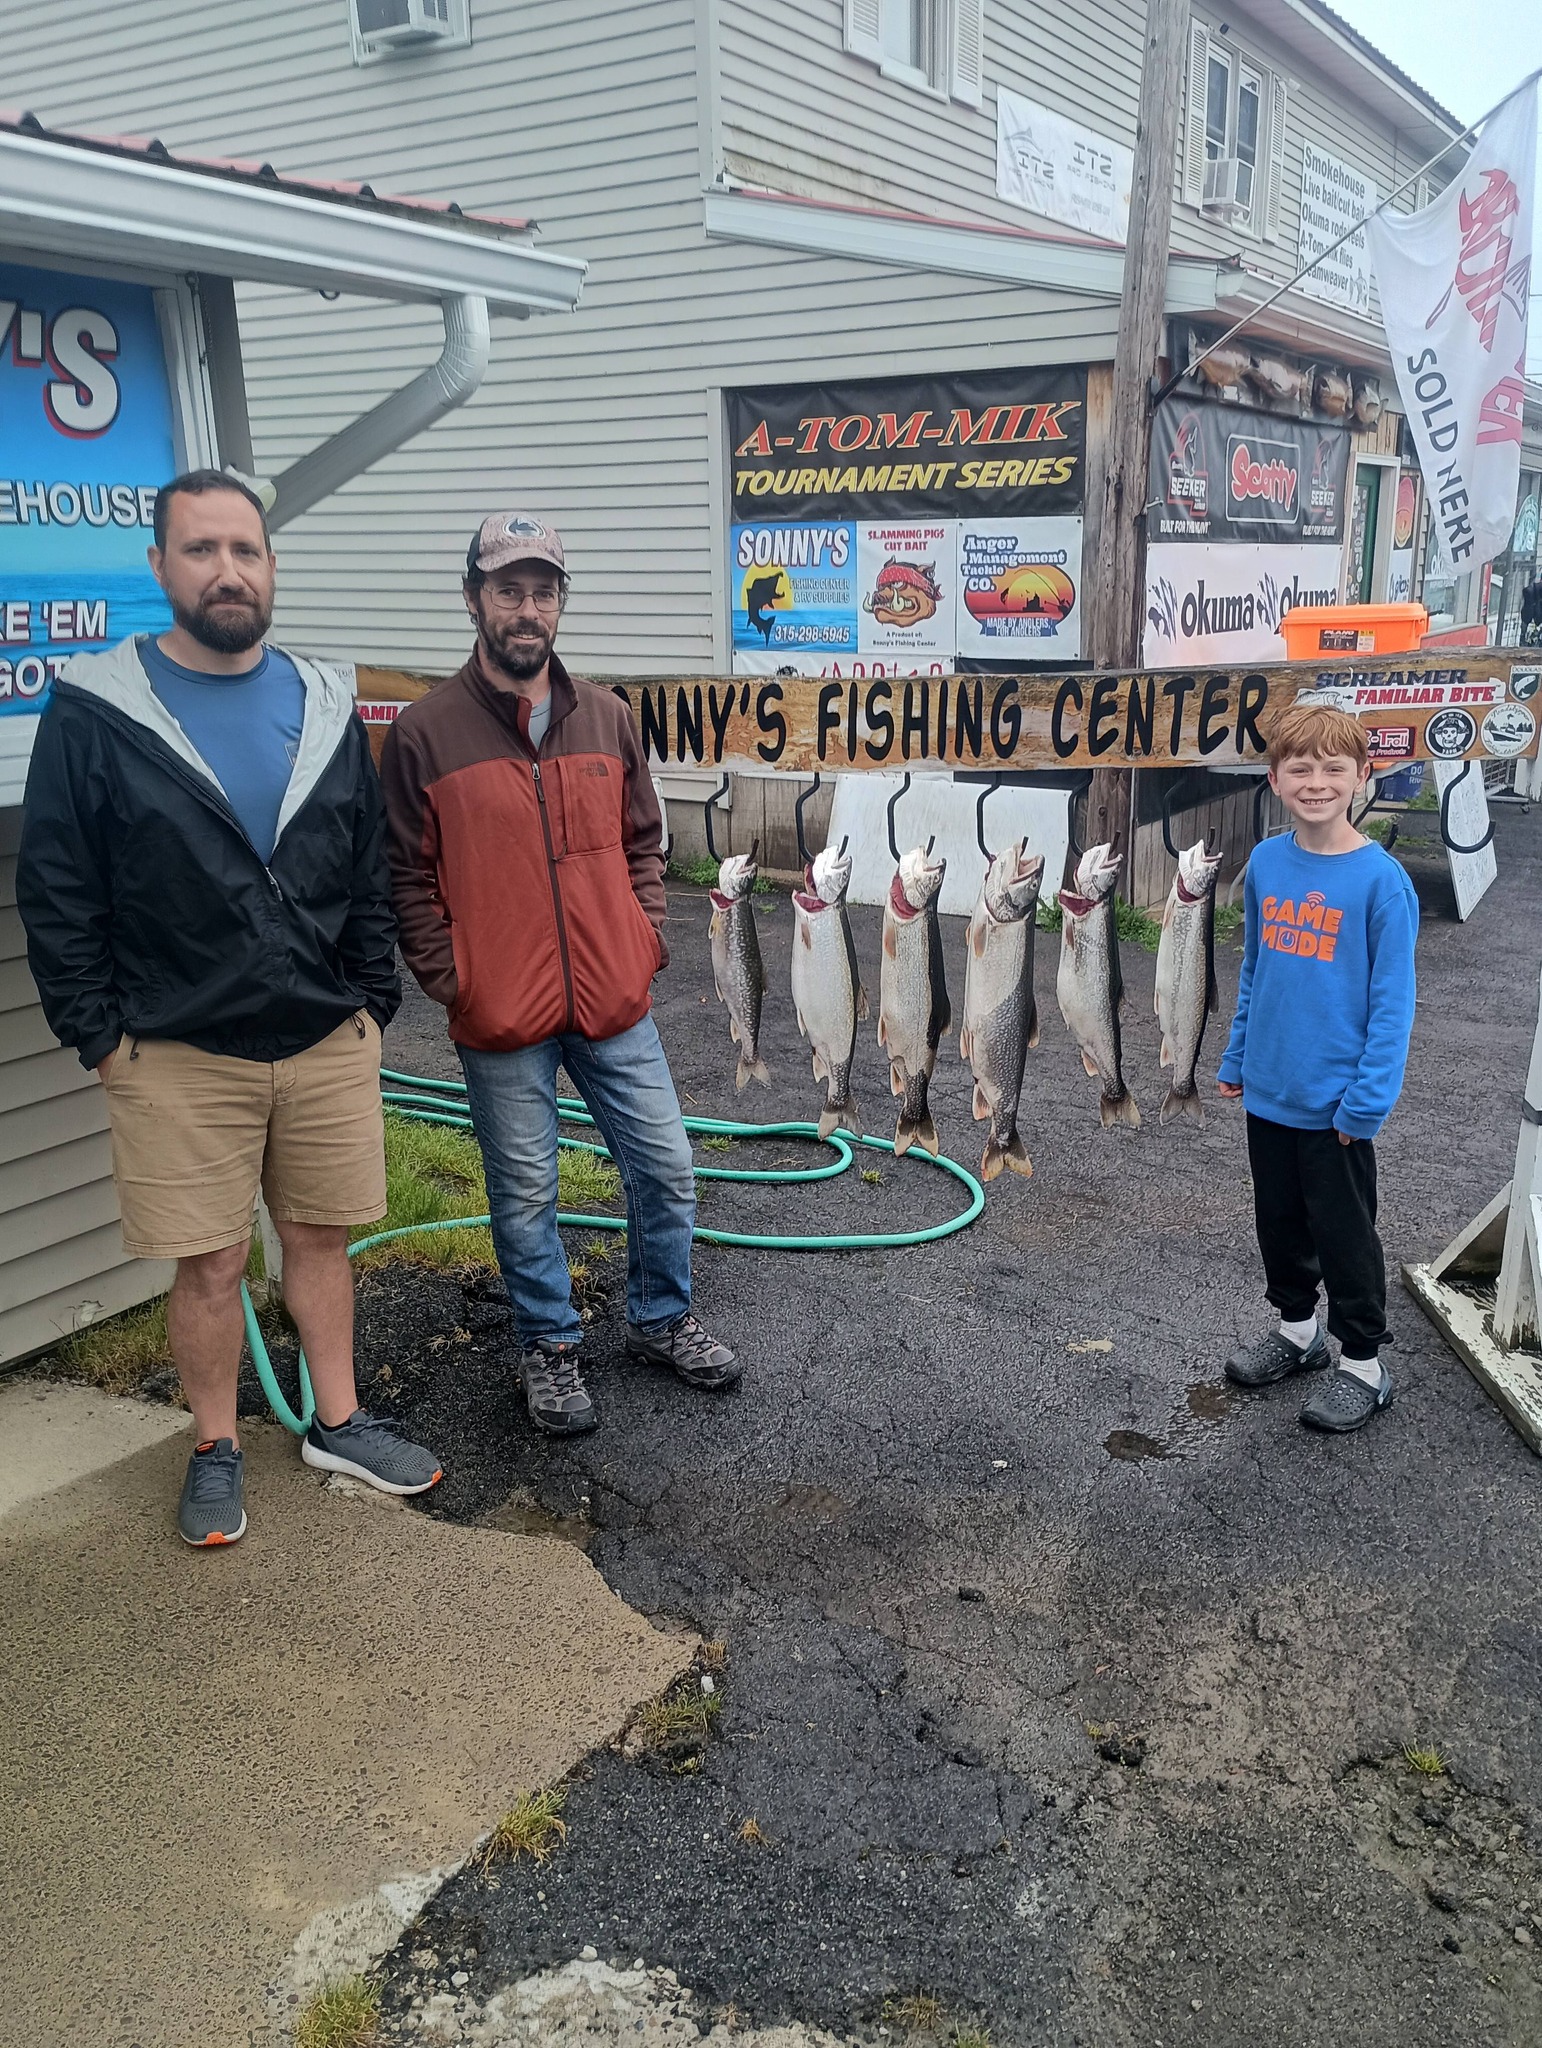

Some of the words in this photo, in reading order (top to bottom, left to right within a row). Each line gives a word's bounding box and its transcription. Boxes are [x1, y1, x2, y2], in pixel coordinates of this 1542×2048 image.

[1305, 146, 1365, 199] Smokehouse
[1303, 173, 1320, 200] Live
[1352, 200, 1365, 221] bait
[1302, 202, 1329, 232] Okuma
[1339, 247, 1353, 269] flies
[1407, 348, 1458, 452] SOLD
[735, 401, 1082, 457] A-TOM-MIK
[735, 461, 956, 496] TOURNAMENT
[956, 456, 1077, 489] SERIES
[1171, 476, 1206, 498] SEEKER
[1231, 443, 1297, 512] Scotty
[1311, 491, 1335, 507] SEEKER
[868, 529, 922, 540] SLAMMING
[924, 528, 944, 539] PIGS
[964, 536, 1017, 552] Anger
[737, 527, 850, 568] SONNY'S
[884, 541, 902, 551] CUT
[905, 541, 928, 551] BAIT
[968, 550, 1066, 567] Management
[962, 565, 1005, 576] Tackle
[790, 578, 819, 590] FISHING
[820, 578, 850, 590] CENTER
[968, 577, 996, 591] CO.
[813, 592, 850, 603] SUPPLIES
[1180, 579, 1254, 638] okuma
[41, 600, 107, 639] 'EM
[986, 617, 1006, 628] MADE
[1008, 617, 1018, 628] BY
[917, 639, 937, 647] Center
[996, 627, 1010, 636] FOR
[1011, 627, 1041, 637] ANGLERS
[1316, 669, 1468, 688] SCREAMER
[1354, 688, 1445, 705] FAMILIAR
[1449, 686, 1496, 702] BITE
[611, 684, 787, 763] NNY'S
[817, 679, 1022, 762] FISHING
[1051, 674, 1268, 757] CENTER
[1262, 896, 1343, 934] GAME
[1262, 923, 1337, 962] MODE
